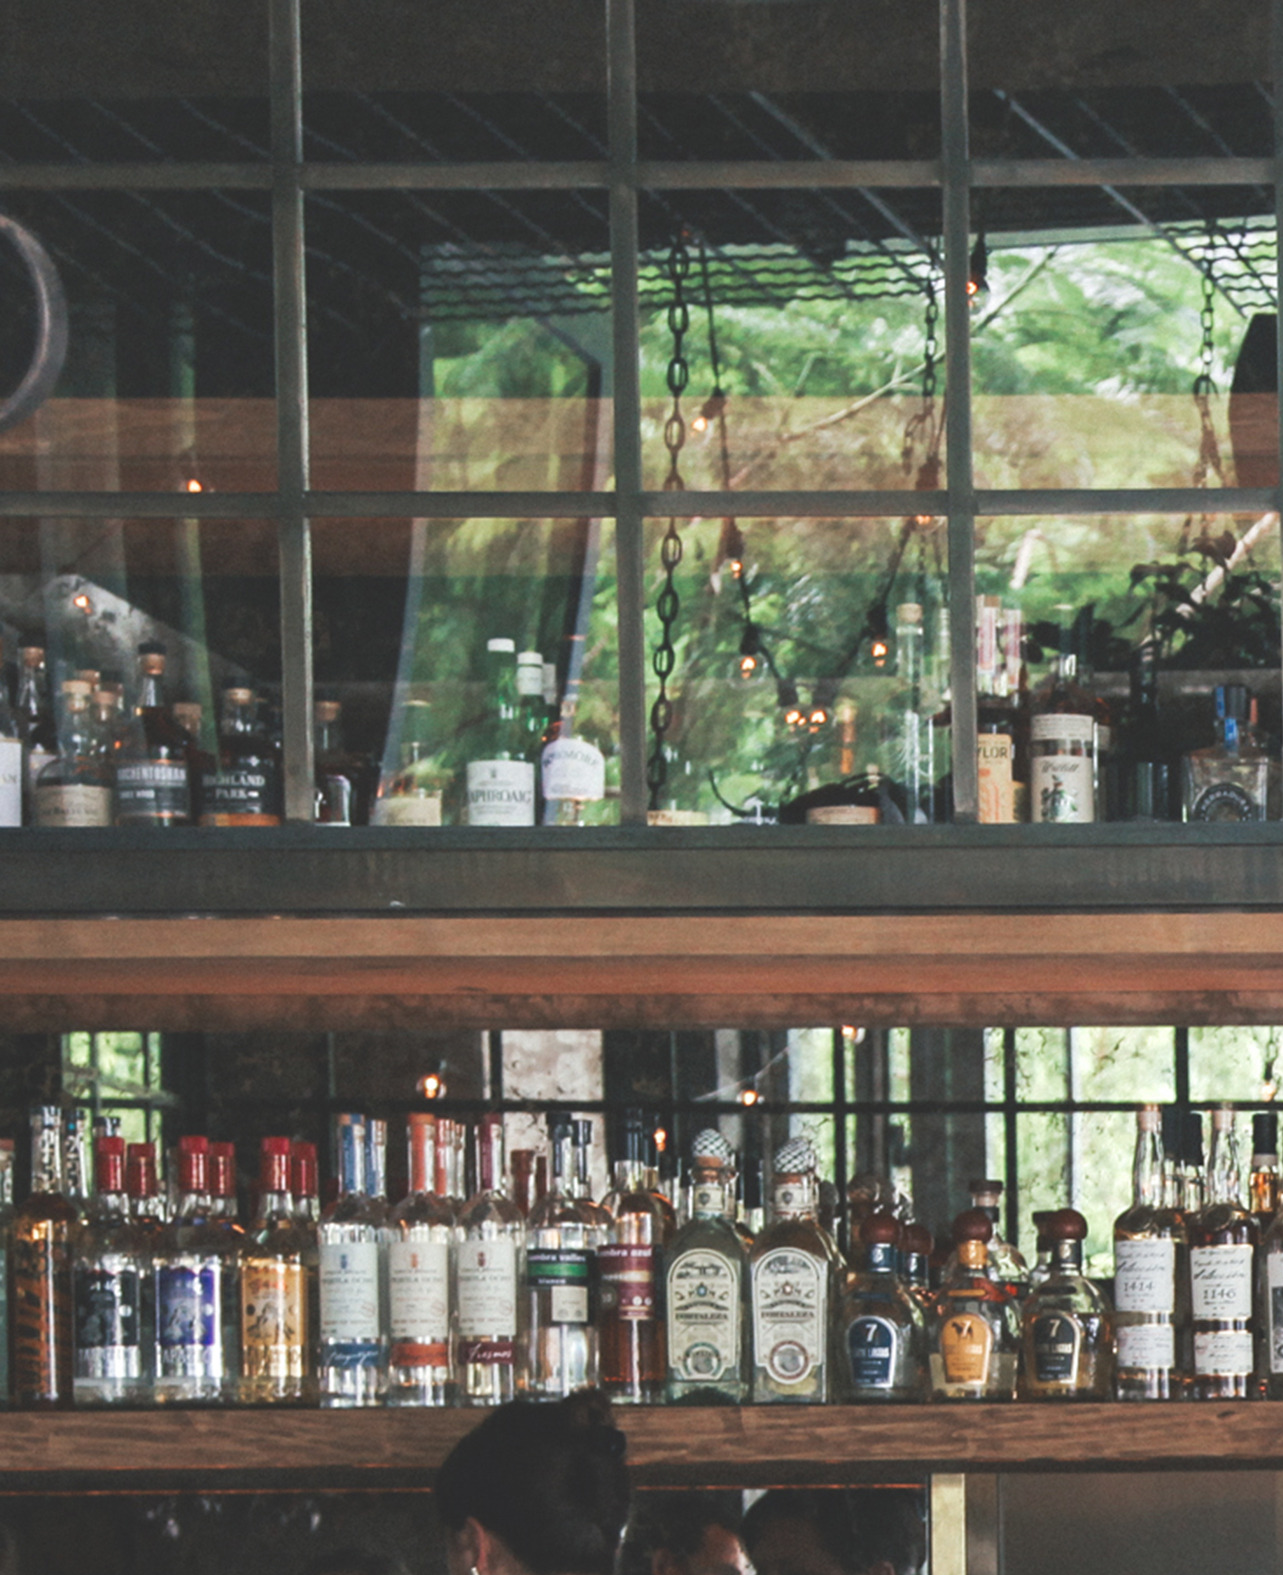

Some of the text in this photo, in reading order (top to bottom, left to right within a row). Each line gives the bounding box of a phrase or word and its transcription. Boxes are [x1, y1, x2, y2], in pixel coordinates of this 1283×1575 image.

[1123, 1281, 1155, 1292] 1414
[1203, 1289, 1236, 1300] 1146
[865, 1323, 878, 1342] 7
[963, 1321, 972, 1338] 7
[1049, 1319, 1061, 1337] 7
